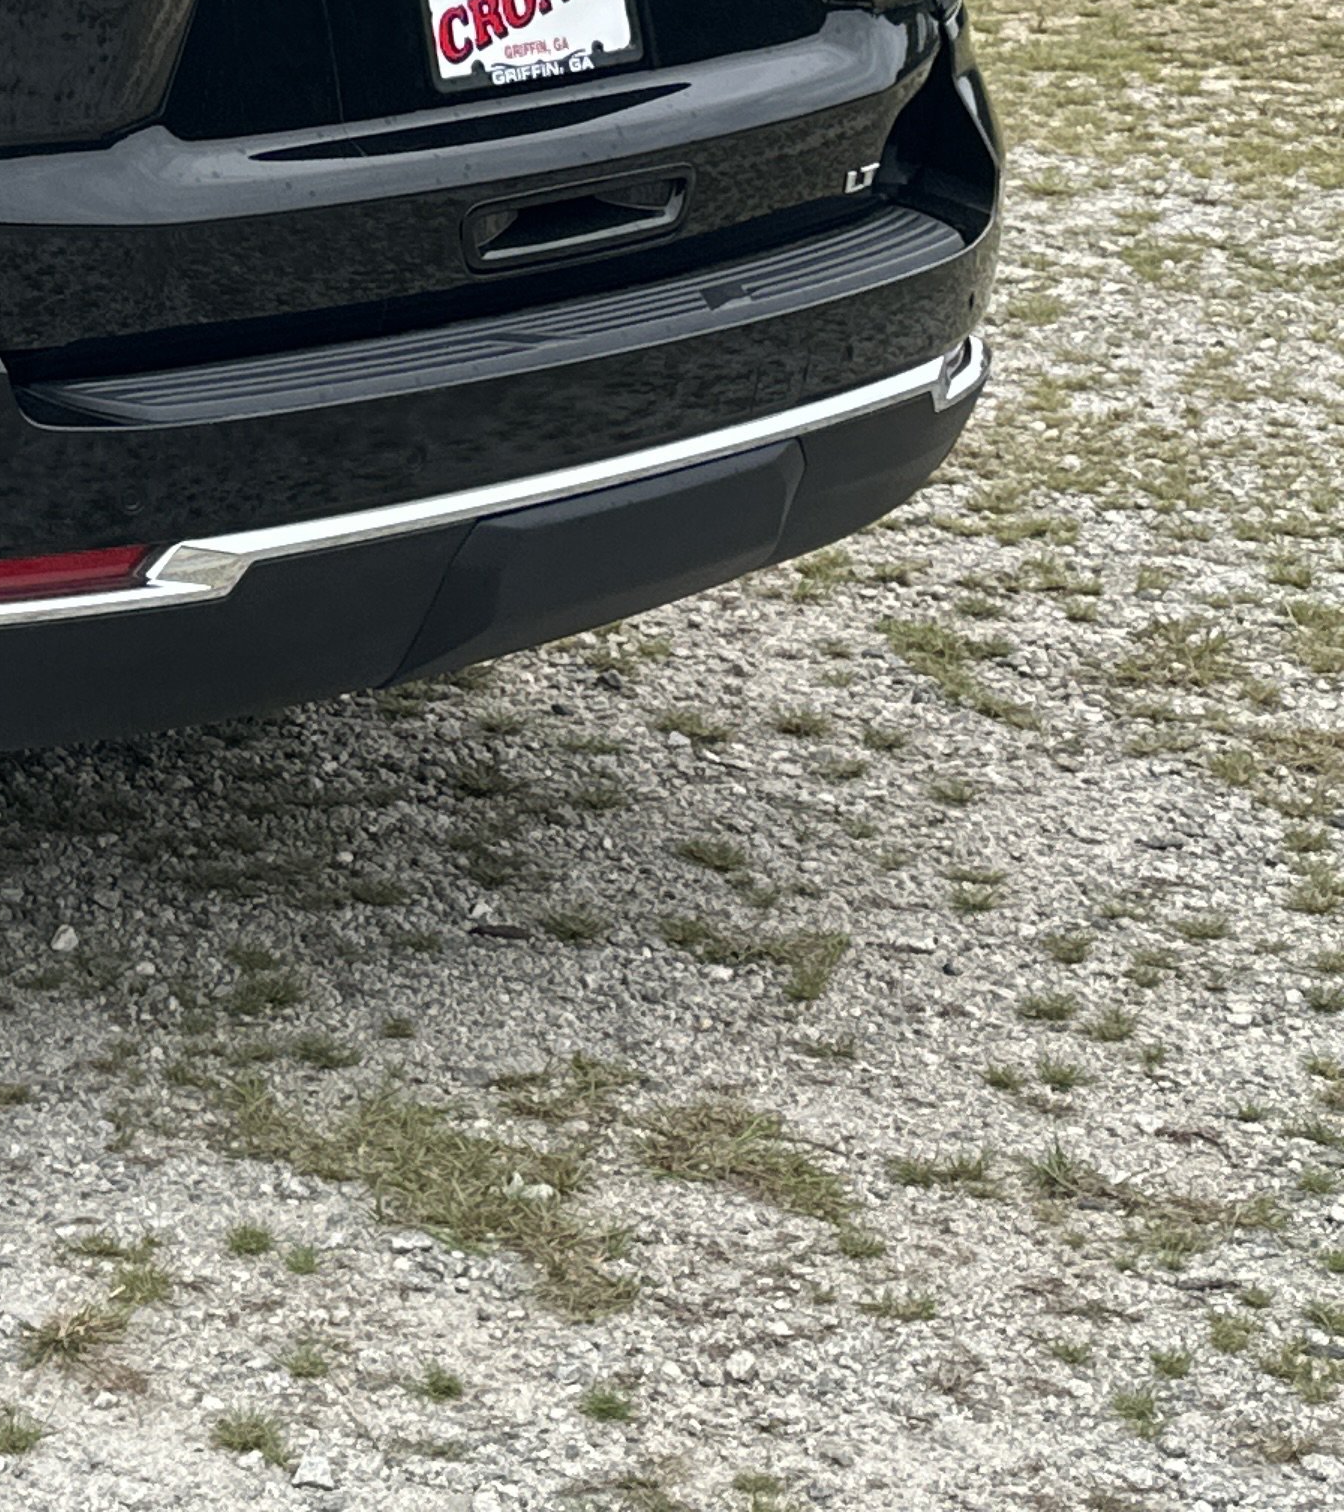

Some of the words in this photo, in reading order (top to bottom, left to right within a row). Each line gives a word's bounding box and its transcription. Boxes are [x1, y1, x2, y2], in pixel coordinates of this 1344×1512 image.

[553, 36, 569, 51] GA
[568, 55, 595, 72] GA
[844, 162, 880, 194] LT
